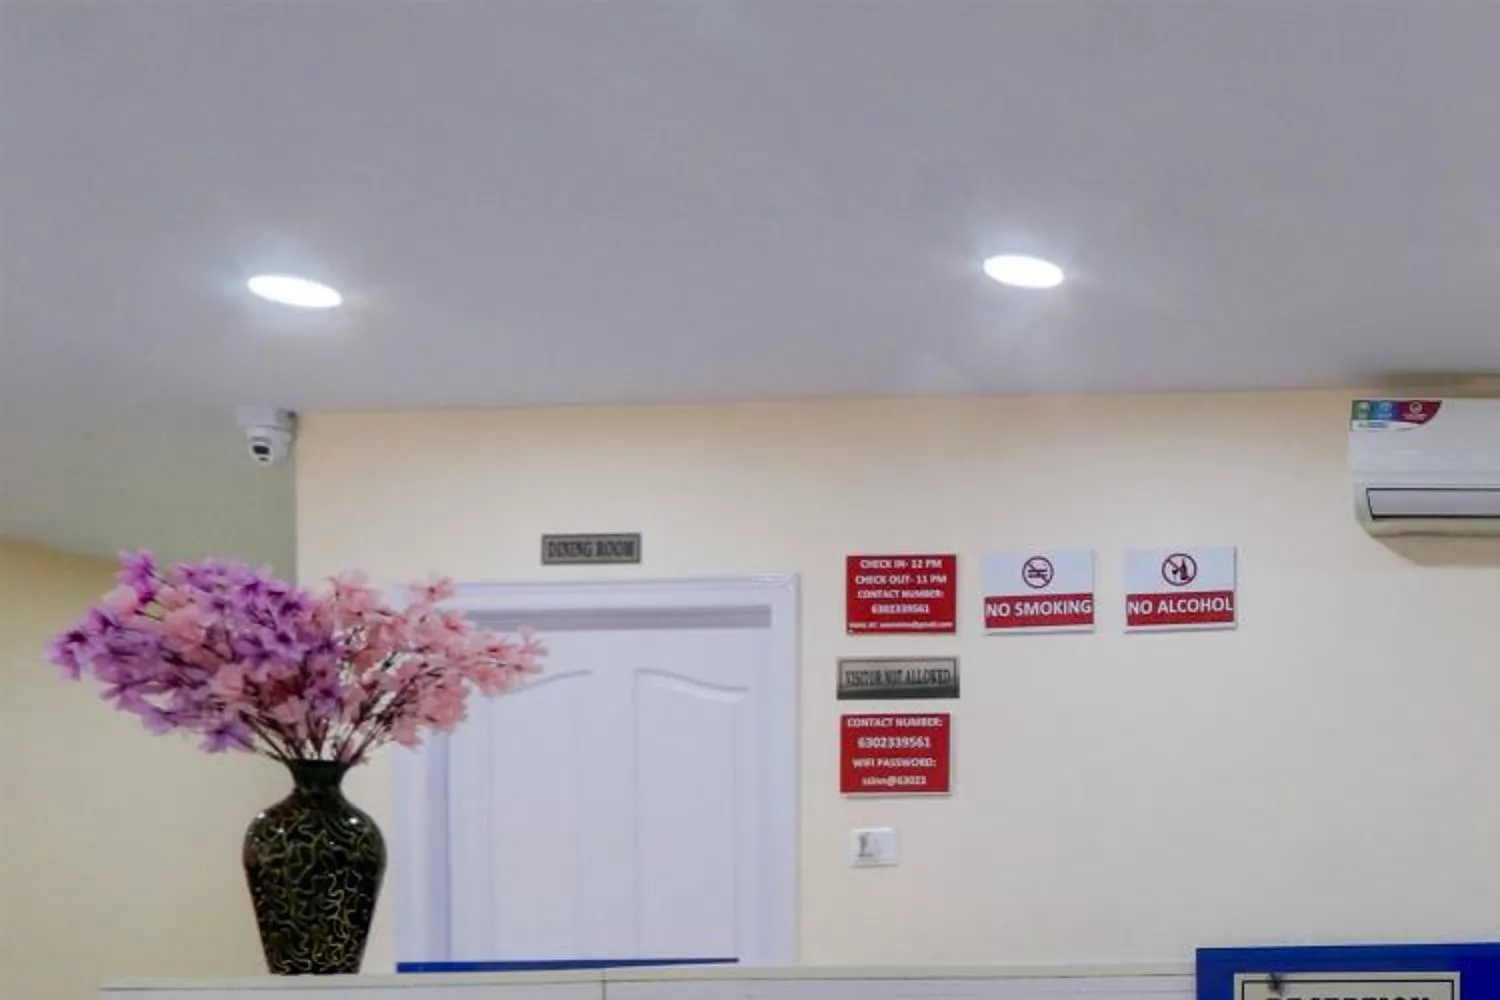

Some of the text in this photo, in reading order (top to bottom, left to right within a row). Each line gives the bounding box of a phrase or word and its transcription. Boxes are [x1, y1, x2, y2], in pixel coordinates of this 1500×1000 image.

[548, 540, 635, 557] DINING ROOM
[860, 560, 892, 568] CHECK
[911, 560, 922, 568] 12
[925, 559, 942, 568] PM
[855, 576, 887, 585] CHECK
[917, 575, 927, 584] 11
[930, 575, 947, 584] PM
[857, 590, 900, 599] CONTACT
[986, 599, 1092, 617] NO SMOKING
[1127, 597, 1233, 615] NO ALCOHOL
[845, 671, 881, 686] VISITOR
[906, 668, 951, 684] ALLOWED
[847, 718, 893, 727] CONTACT
